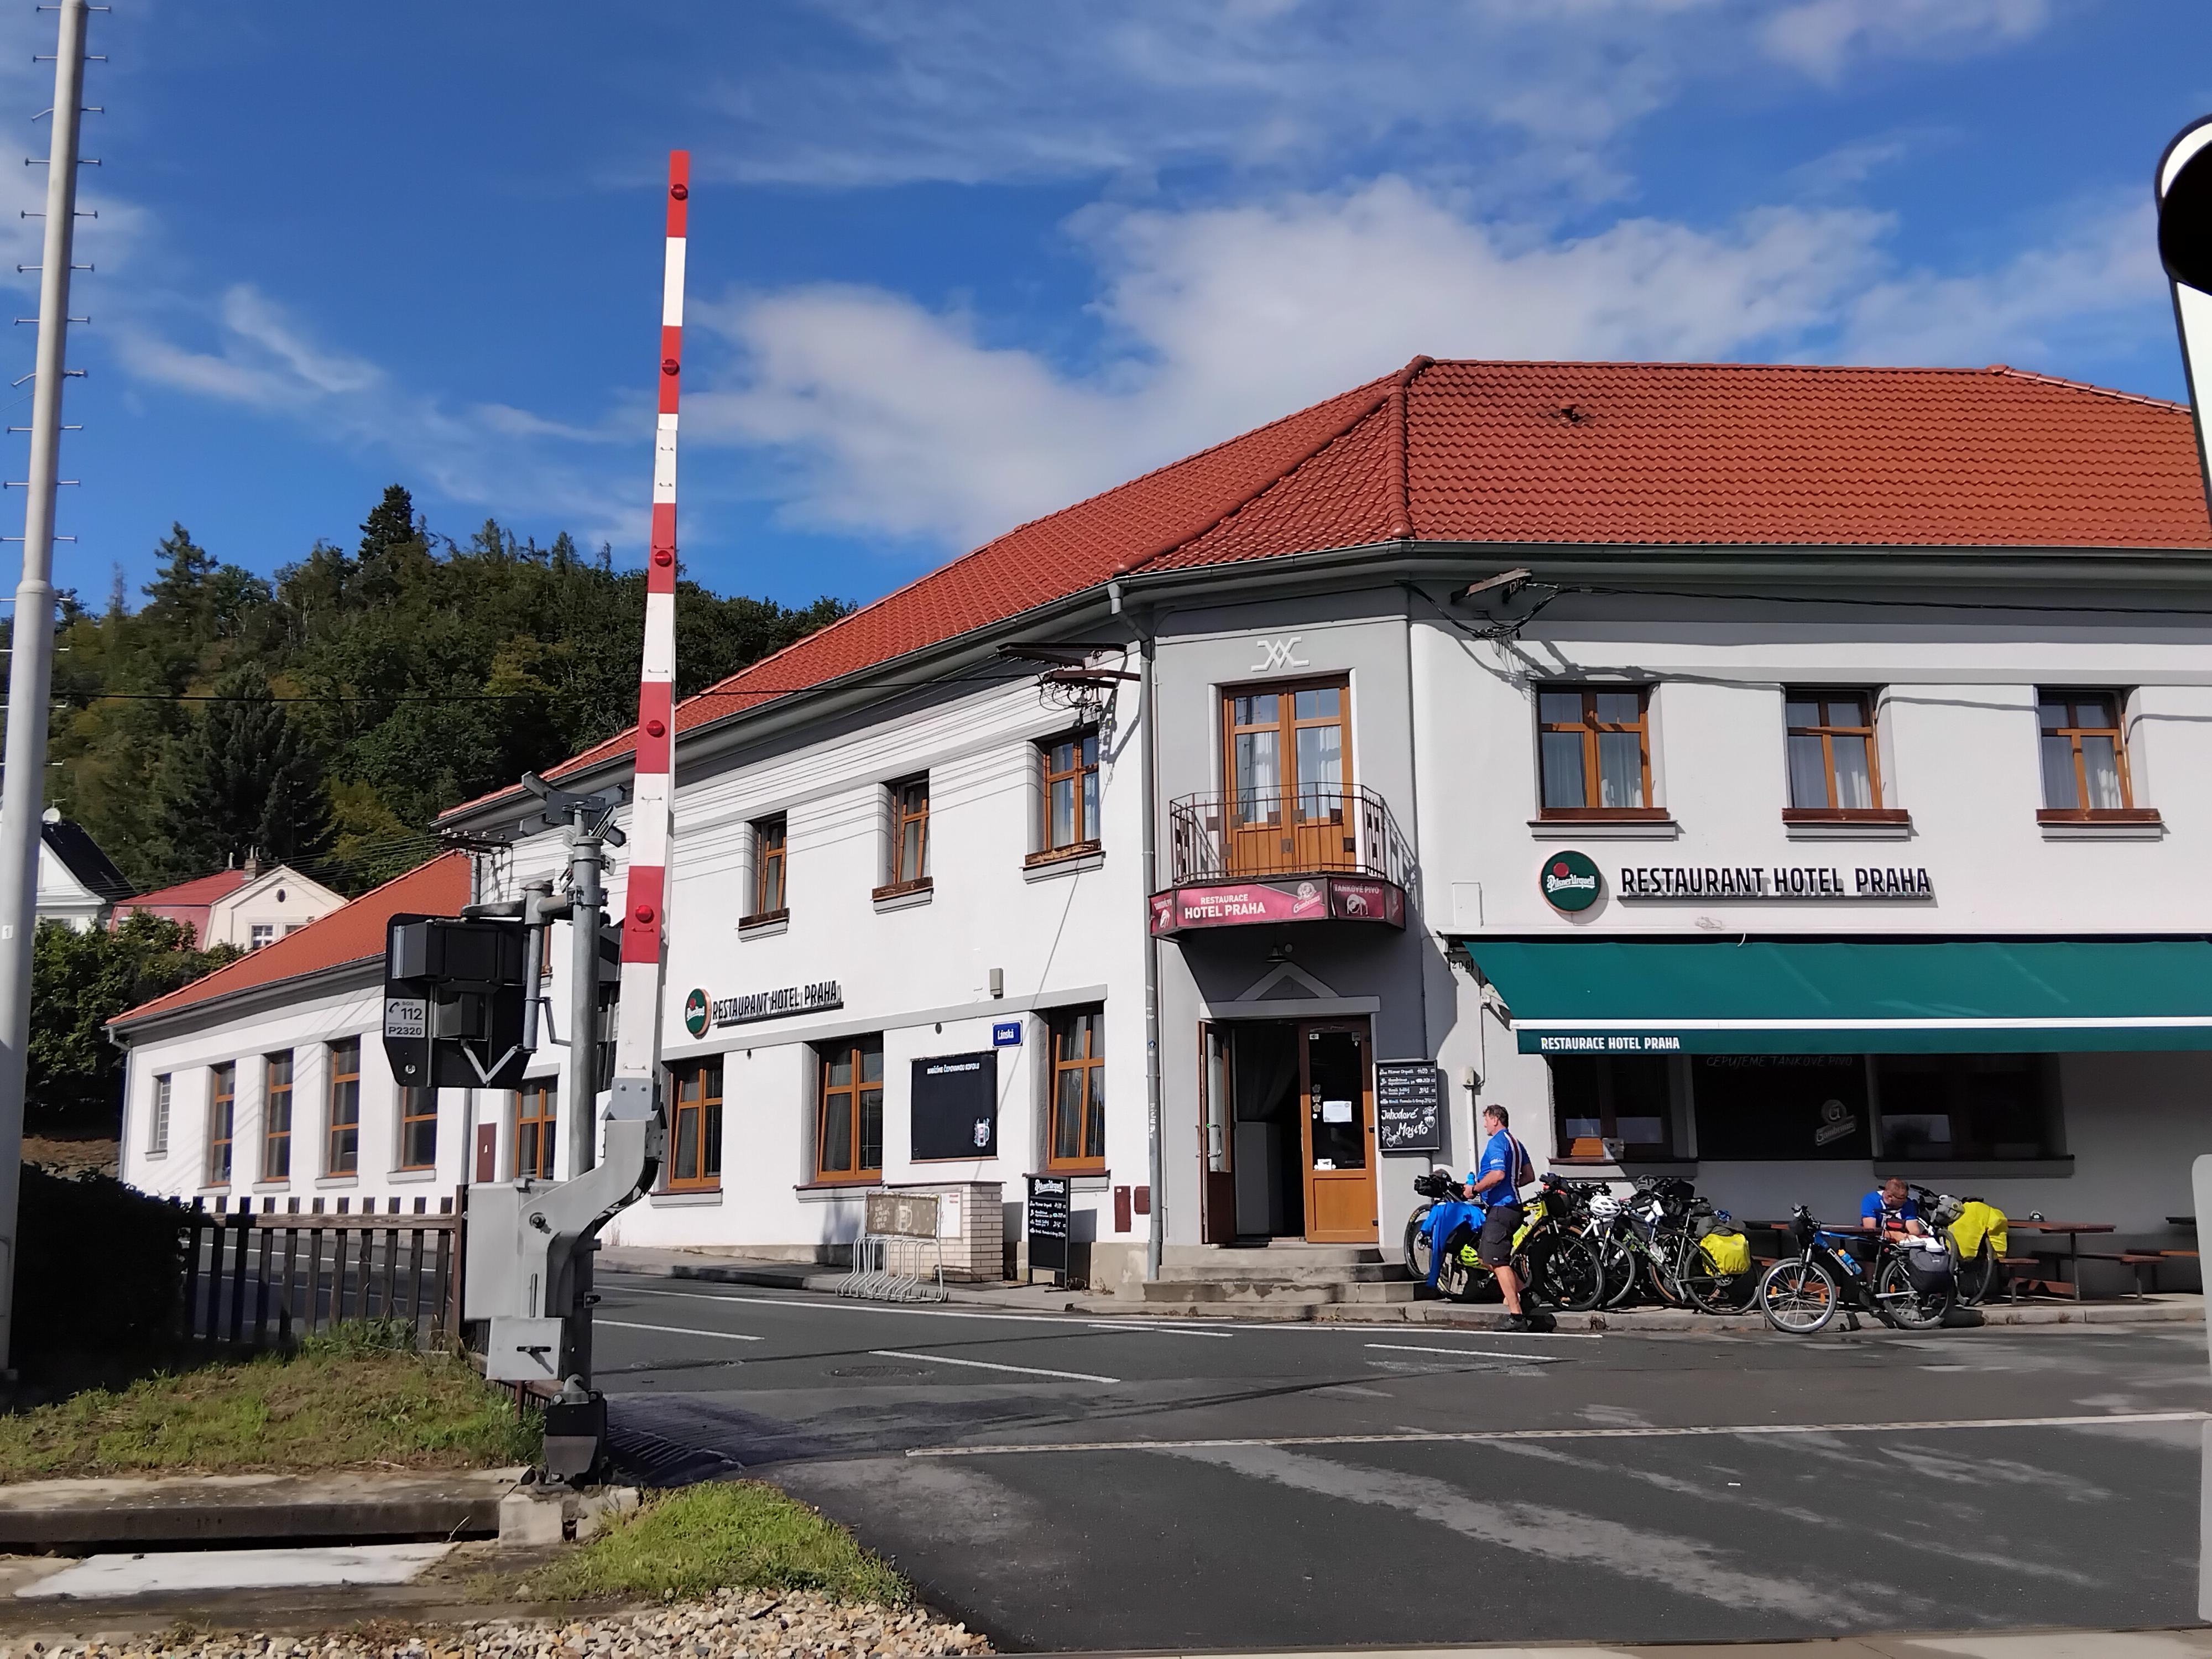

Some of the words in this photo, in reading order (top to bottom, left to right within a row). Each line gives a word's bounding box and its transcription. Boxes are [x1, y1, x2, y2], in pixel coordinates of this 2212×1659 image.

[1334, 884, 1364, 893] TANKOVÉ
[1547, 874, 1571, 893] Pilsner
[1570, 874, 1595, 889] Urquell
[1621, 868, 1764, 893] RESTAURANT
[1773, 867, 1844, 893] HOTEL
[1855, 868, 1931, 892] PRAHA
[1201, 894, 1248, 905] RESTAURACE
[1293, 895, 1321, 914] Gambrinus
[1185, 905, 1223, 919] HOTEL
[1224, 902, 1266, 916] PRAHA
[713, 992, 769, 1020] RESTAURANT
[771, 987, 799, 1010] HOTEL
[805, 980, 836, 1005] PRAHA
[401, 1008, 422, 1020] 112
[389, 1026, 422, 1035] P2320
[1541, 1037, 1605, 1049] RESTAURACE
[1608, 1037, 1641, 1049] HOTEL
[1644, 1037, 1680, 1049] PRAHA
[1396, 1120, 1428, 1139] Mojito
